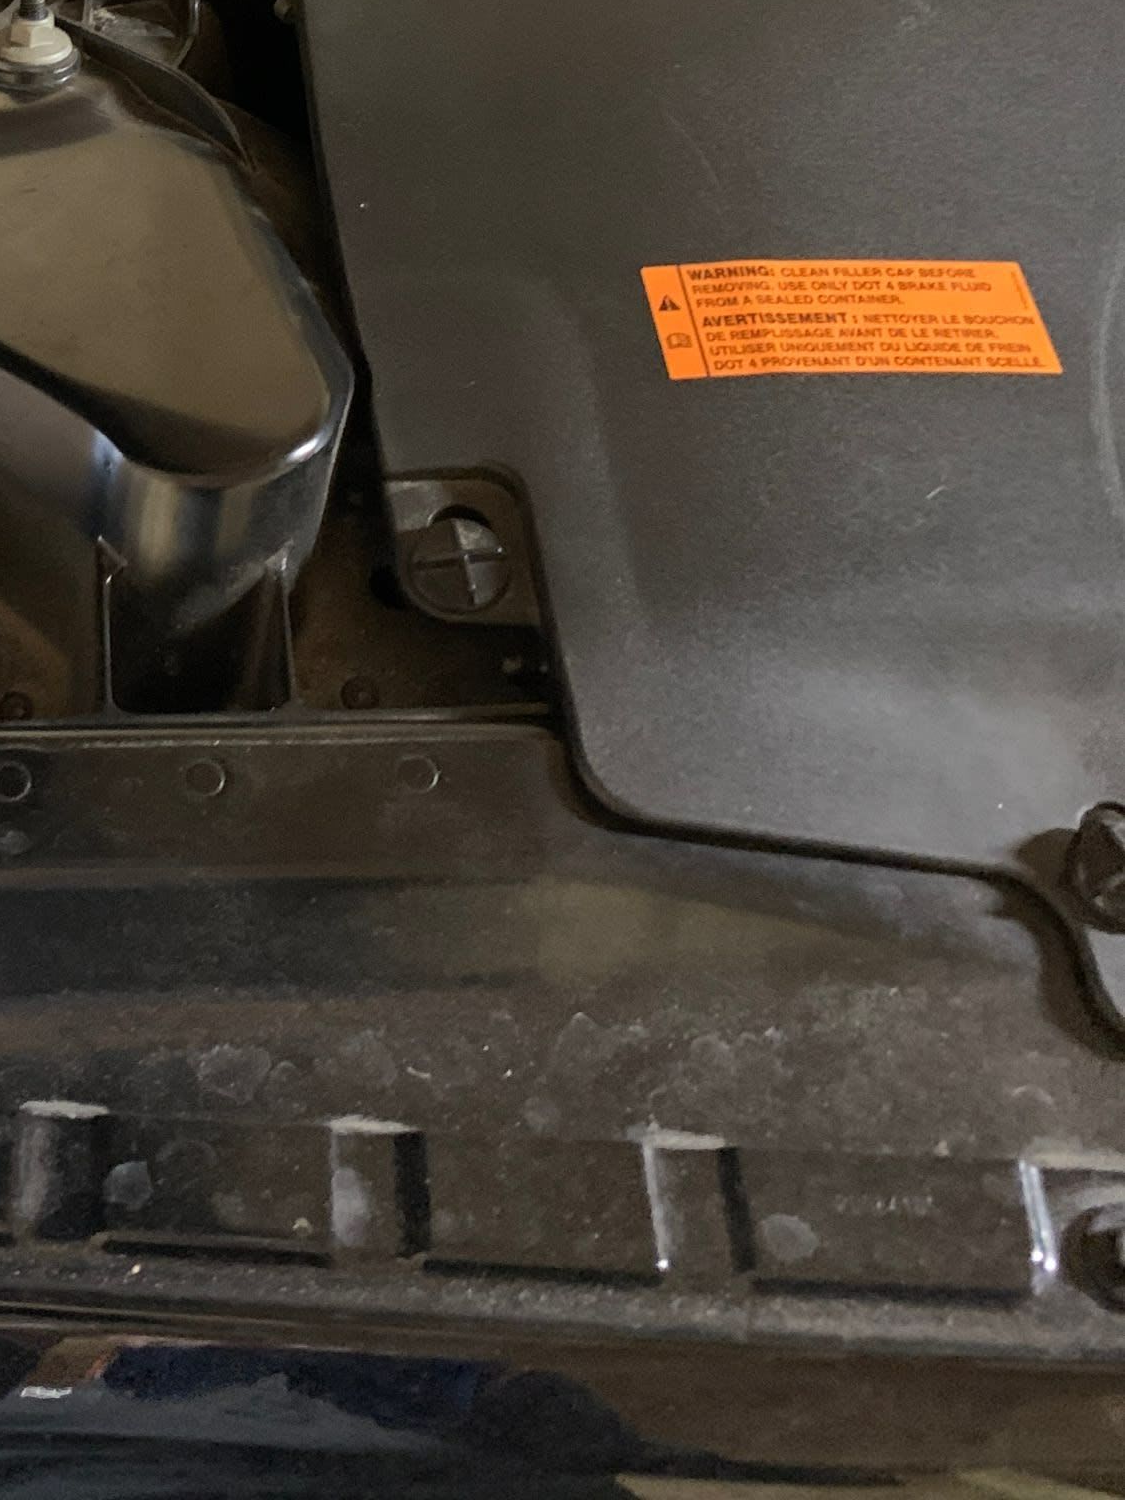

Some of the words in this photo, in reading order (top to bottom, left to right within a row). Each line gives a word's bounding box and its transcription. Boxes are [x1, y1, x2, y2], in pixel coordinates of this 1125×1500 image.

[687, 266, 775, 280] WARNING:
[780, 267, 830, 278] CLEAN
[833, 267, 882, 277] FILLER
[886, 267, 914, 277] CAP
[918, 268, 976, 278] BEFORE
[778, 280, 807, 292] USE
[811, 280, 848, 291] ONLY
[852, 280, 881, 291] DOT
[886, 281, 895, 291] 4
[898, 281, 947, 291] BRAKE
[950, 282, 993, 292] FLUID
[696, 297, 740, 309] FROM
[742, 296, 753, 306] A
[758, 295, 814, 306] SEALED
[818, 294, 904, 305] CONTAINER.
[702, 312, 848, 328] AVERTISSEMENT
[862, 314, 939, 325] NETTOYER
[942, 315, 960, 325] LE
[963, 315, 1035, 325] BOUCHON
[706, 331, 726, 343] DE
[730, 328, 835, 341] REMPLISSAGE
[839, 328, 883, 338] AVANT
[888, 328, 907, 338] DE
[911, 328, 929, 338] LE
[933, 328, 999, 339] RETIRER.
[711, 343, 774, 357] UTILISER
[779, 342, 875, 353] UNIQUEMENT
[879, 342, 900, 352] DU
[904, 342, 960, 352] LIQUIDE
[965, 342, 984, 352] DE
[988, 343, 1031, 353] FREIN
[714, 359, 744, 371] DOT
[749, 359, 758, 369] 4
[761, 357, 851, 368] PROVENANT
[855, 356, 891, 367] D'UN
[894, 356, 982, 367] CONTENANT
